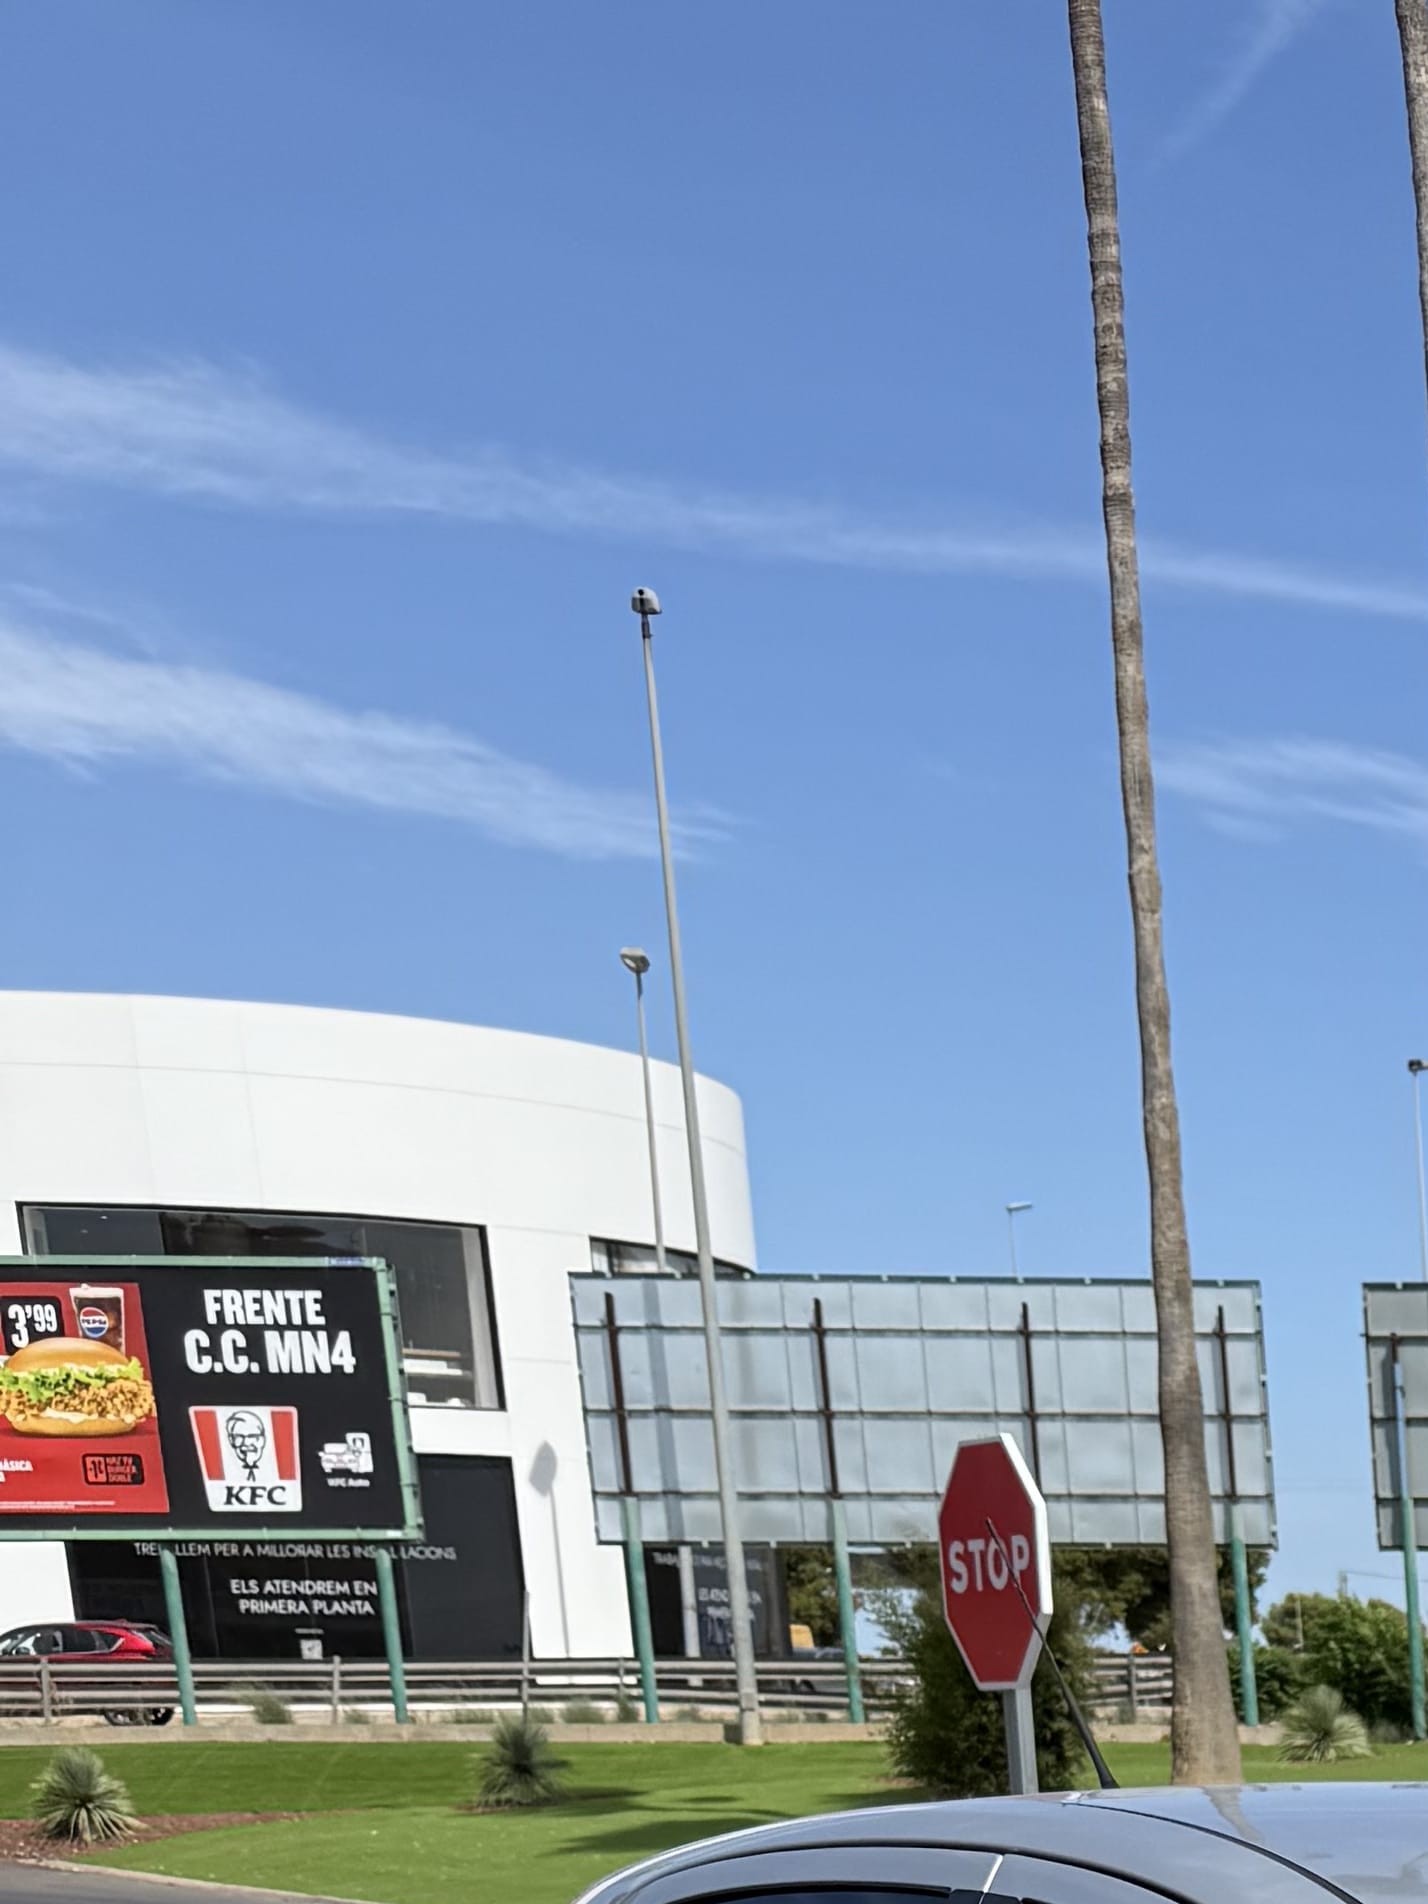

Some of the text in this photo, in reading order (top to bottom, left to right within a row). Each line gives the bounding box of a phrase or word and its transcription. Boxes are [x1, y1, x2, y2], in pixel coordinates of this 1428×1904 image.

[203, 1288, 326, 1326] FRENTE
[183, 1328, 357, 1375] C.C. MN4
[0, 1457, 34, 1472] ÁSICA
[223, 1485, 287, 1506] KFC
[134, 1542, 211, 1558] TRELLEM
[214, 1543, 240, 1557] PER
[242, 1543, 254, 1557] A
[256, 1543, 325, 1559] MILLORAR
[326, 1544, 351, 1559] LES
[949, 1534, 1031, 1595] STOP
[229, 1578, 378, 1597] ELS ATENDREM EN
[238, 1598, 376, 1616] PRIMERA PLANTA
